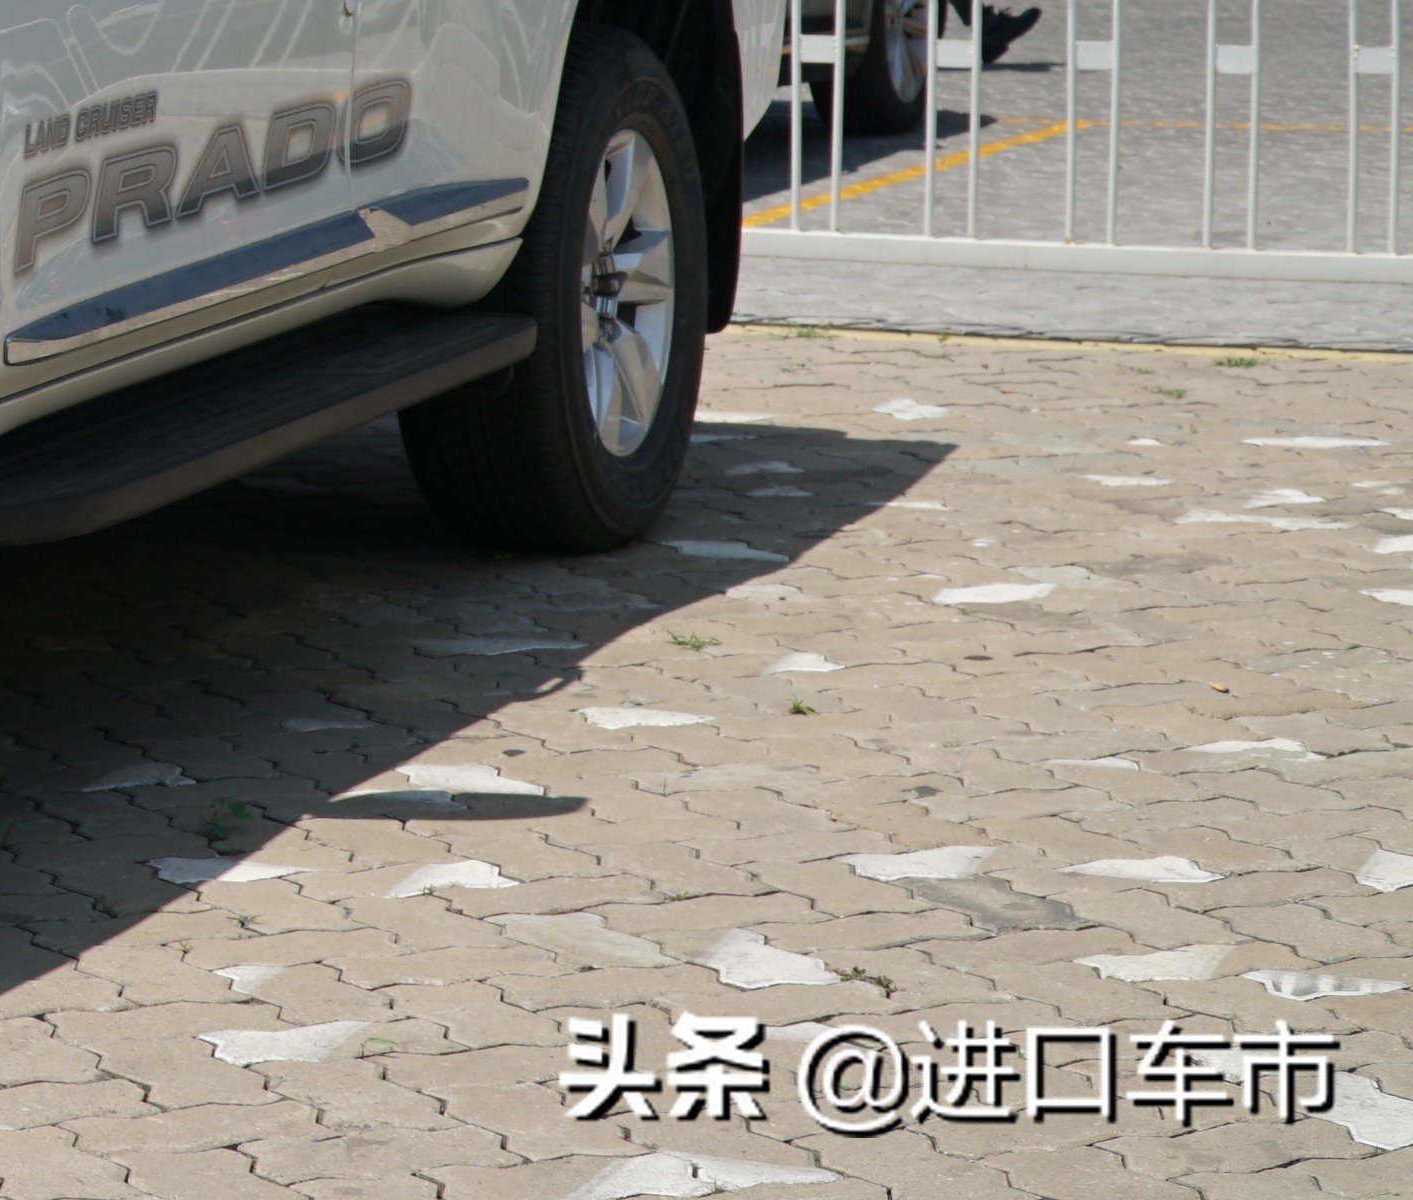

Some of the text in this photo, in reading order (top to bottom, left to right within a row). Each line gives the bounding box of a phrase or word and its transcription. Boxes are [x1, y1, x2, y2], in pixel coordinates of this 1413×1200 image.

[13, 79, 412, 275] PRADO
[24, 91, 158, 158] LAND CRUISER
